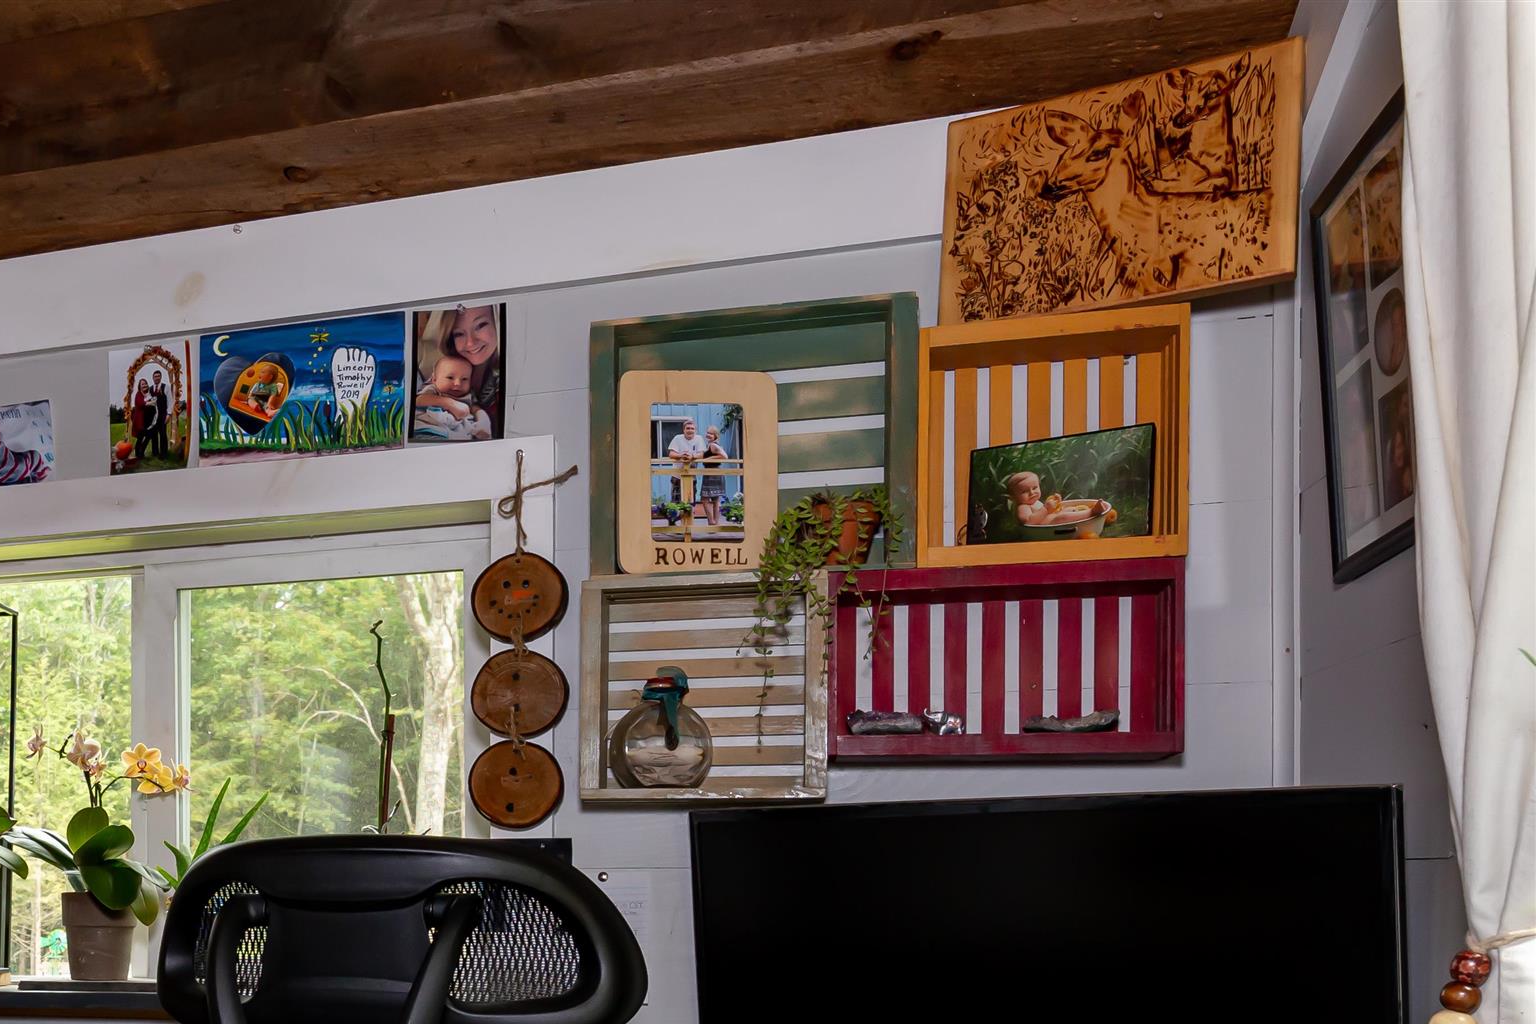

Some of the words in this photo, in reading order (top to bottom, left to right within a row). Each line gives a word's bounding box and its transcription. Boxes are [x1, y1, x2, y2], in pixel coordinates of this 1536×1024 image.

[337, 364, 374, 372] Lincoln
[337, 374, 372, 385] Timothy
[341, 389, 360, 400] 2019
[654, 547, 748, 566] ROWELL
